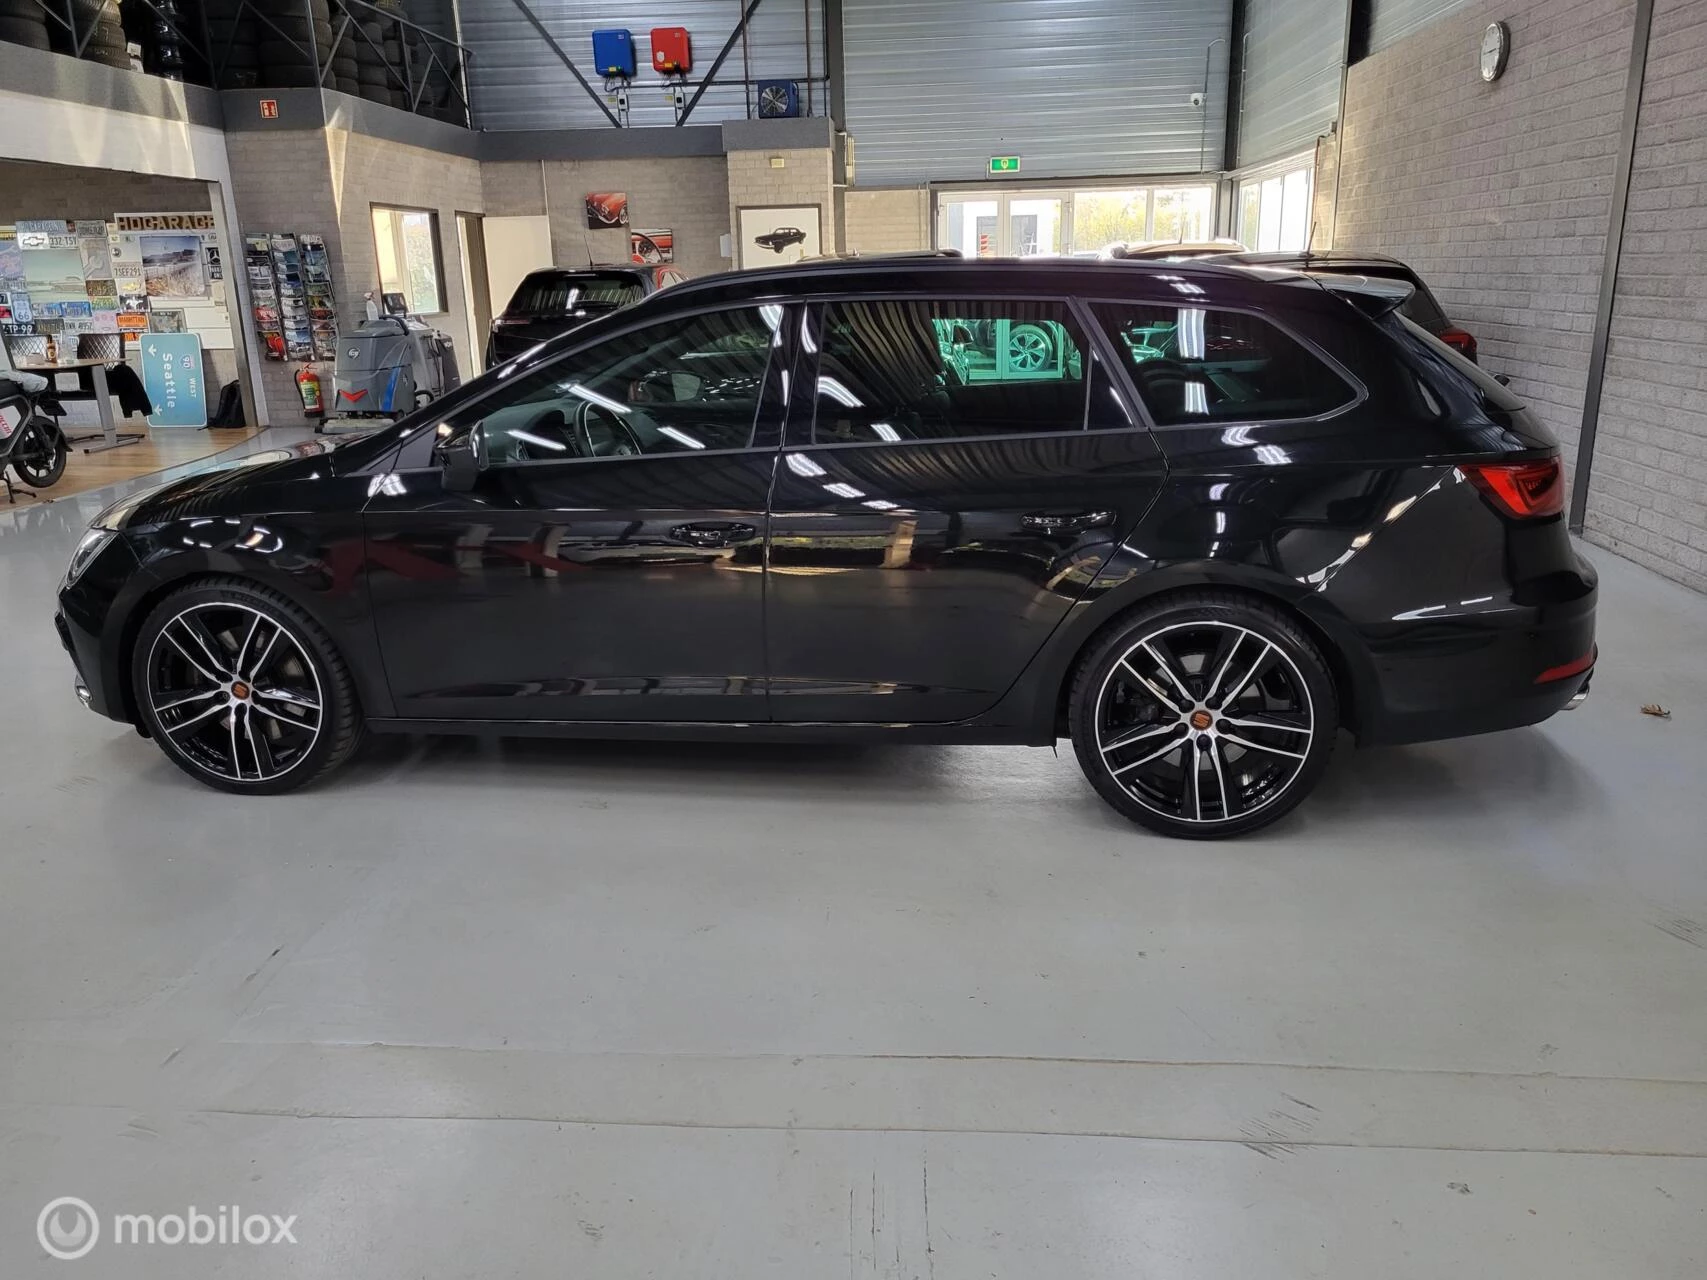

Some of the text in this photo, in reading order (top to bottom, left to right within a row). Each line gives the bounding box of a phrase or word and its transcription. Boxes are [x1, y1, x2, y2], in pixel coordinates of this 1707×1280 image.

[17, 311, 30, 320] 66
[162, 352, 177, 409] Seattle
[189, 377, 197, 399] WEST
